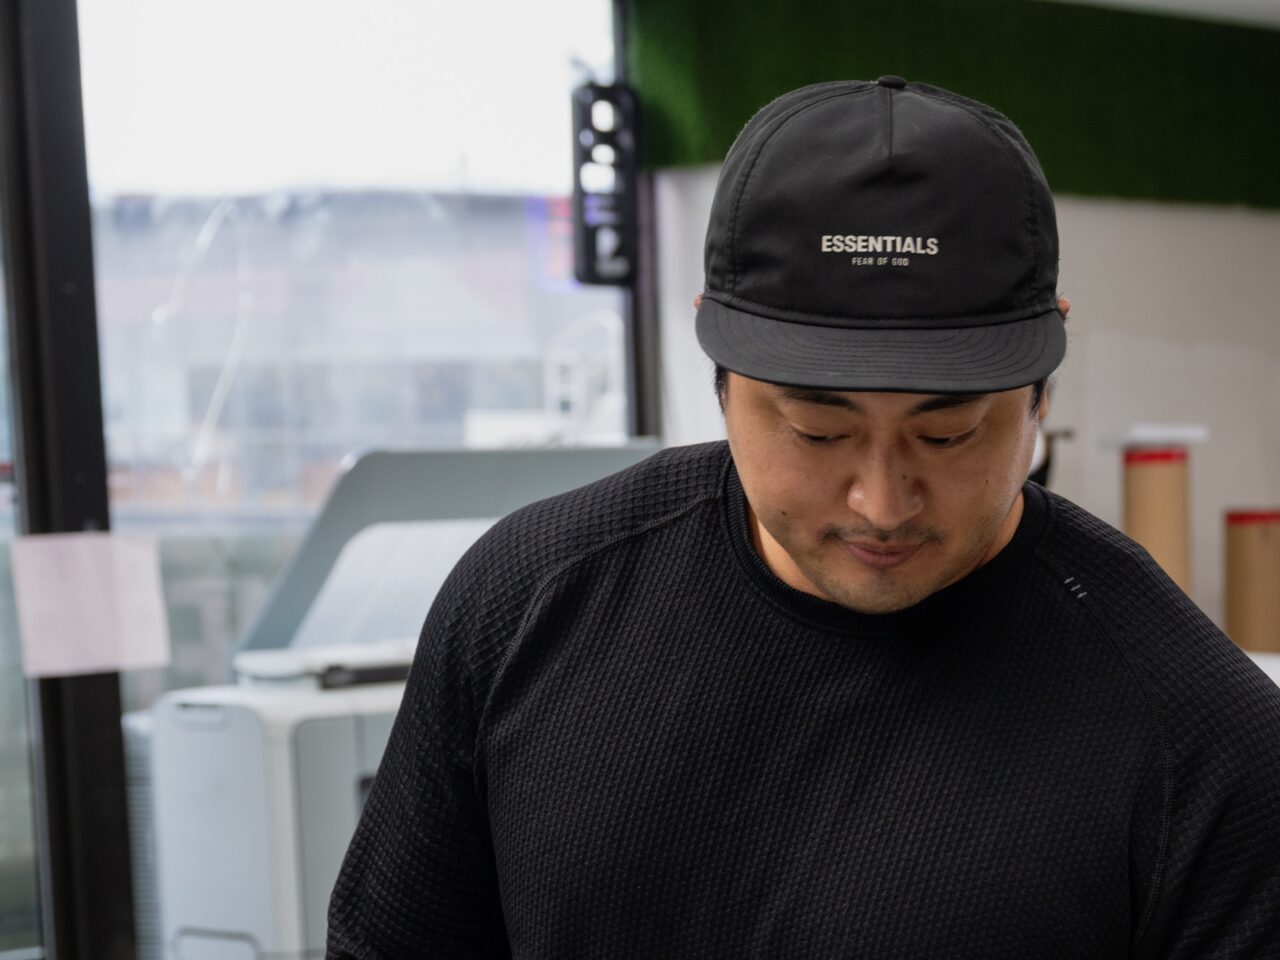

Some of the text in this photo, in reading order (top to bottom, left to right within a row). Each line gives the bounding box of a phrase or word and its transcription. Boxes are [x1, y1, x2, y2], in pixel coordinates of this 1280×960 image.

[821, 235, 940, 256] ESSENTIALS
[851, 256, 910, 267] FEAR OF GOD
